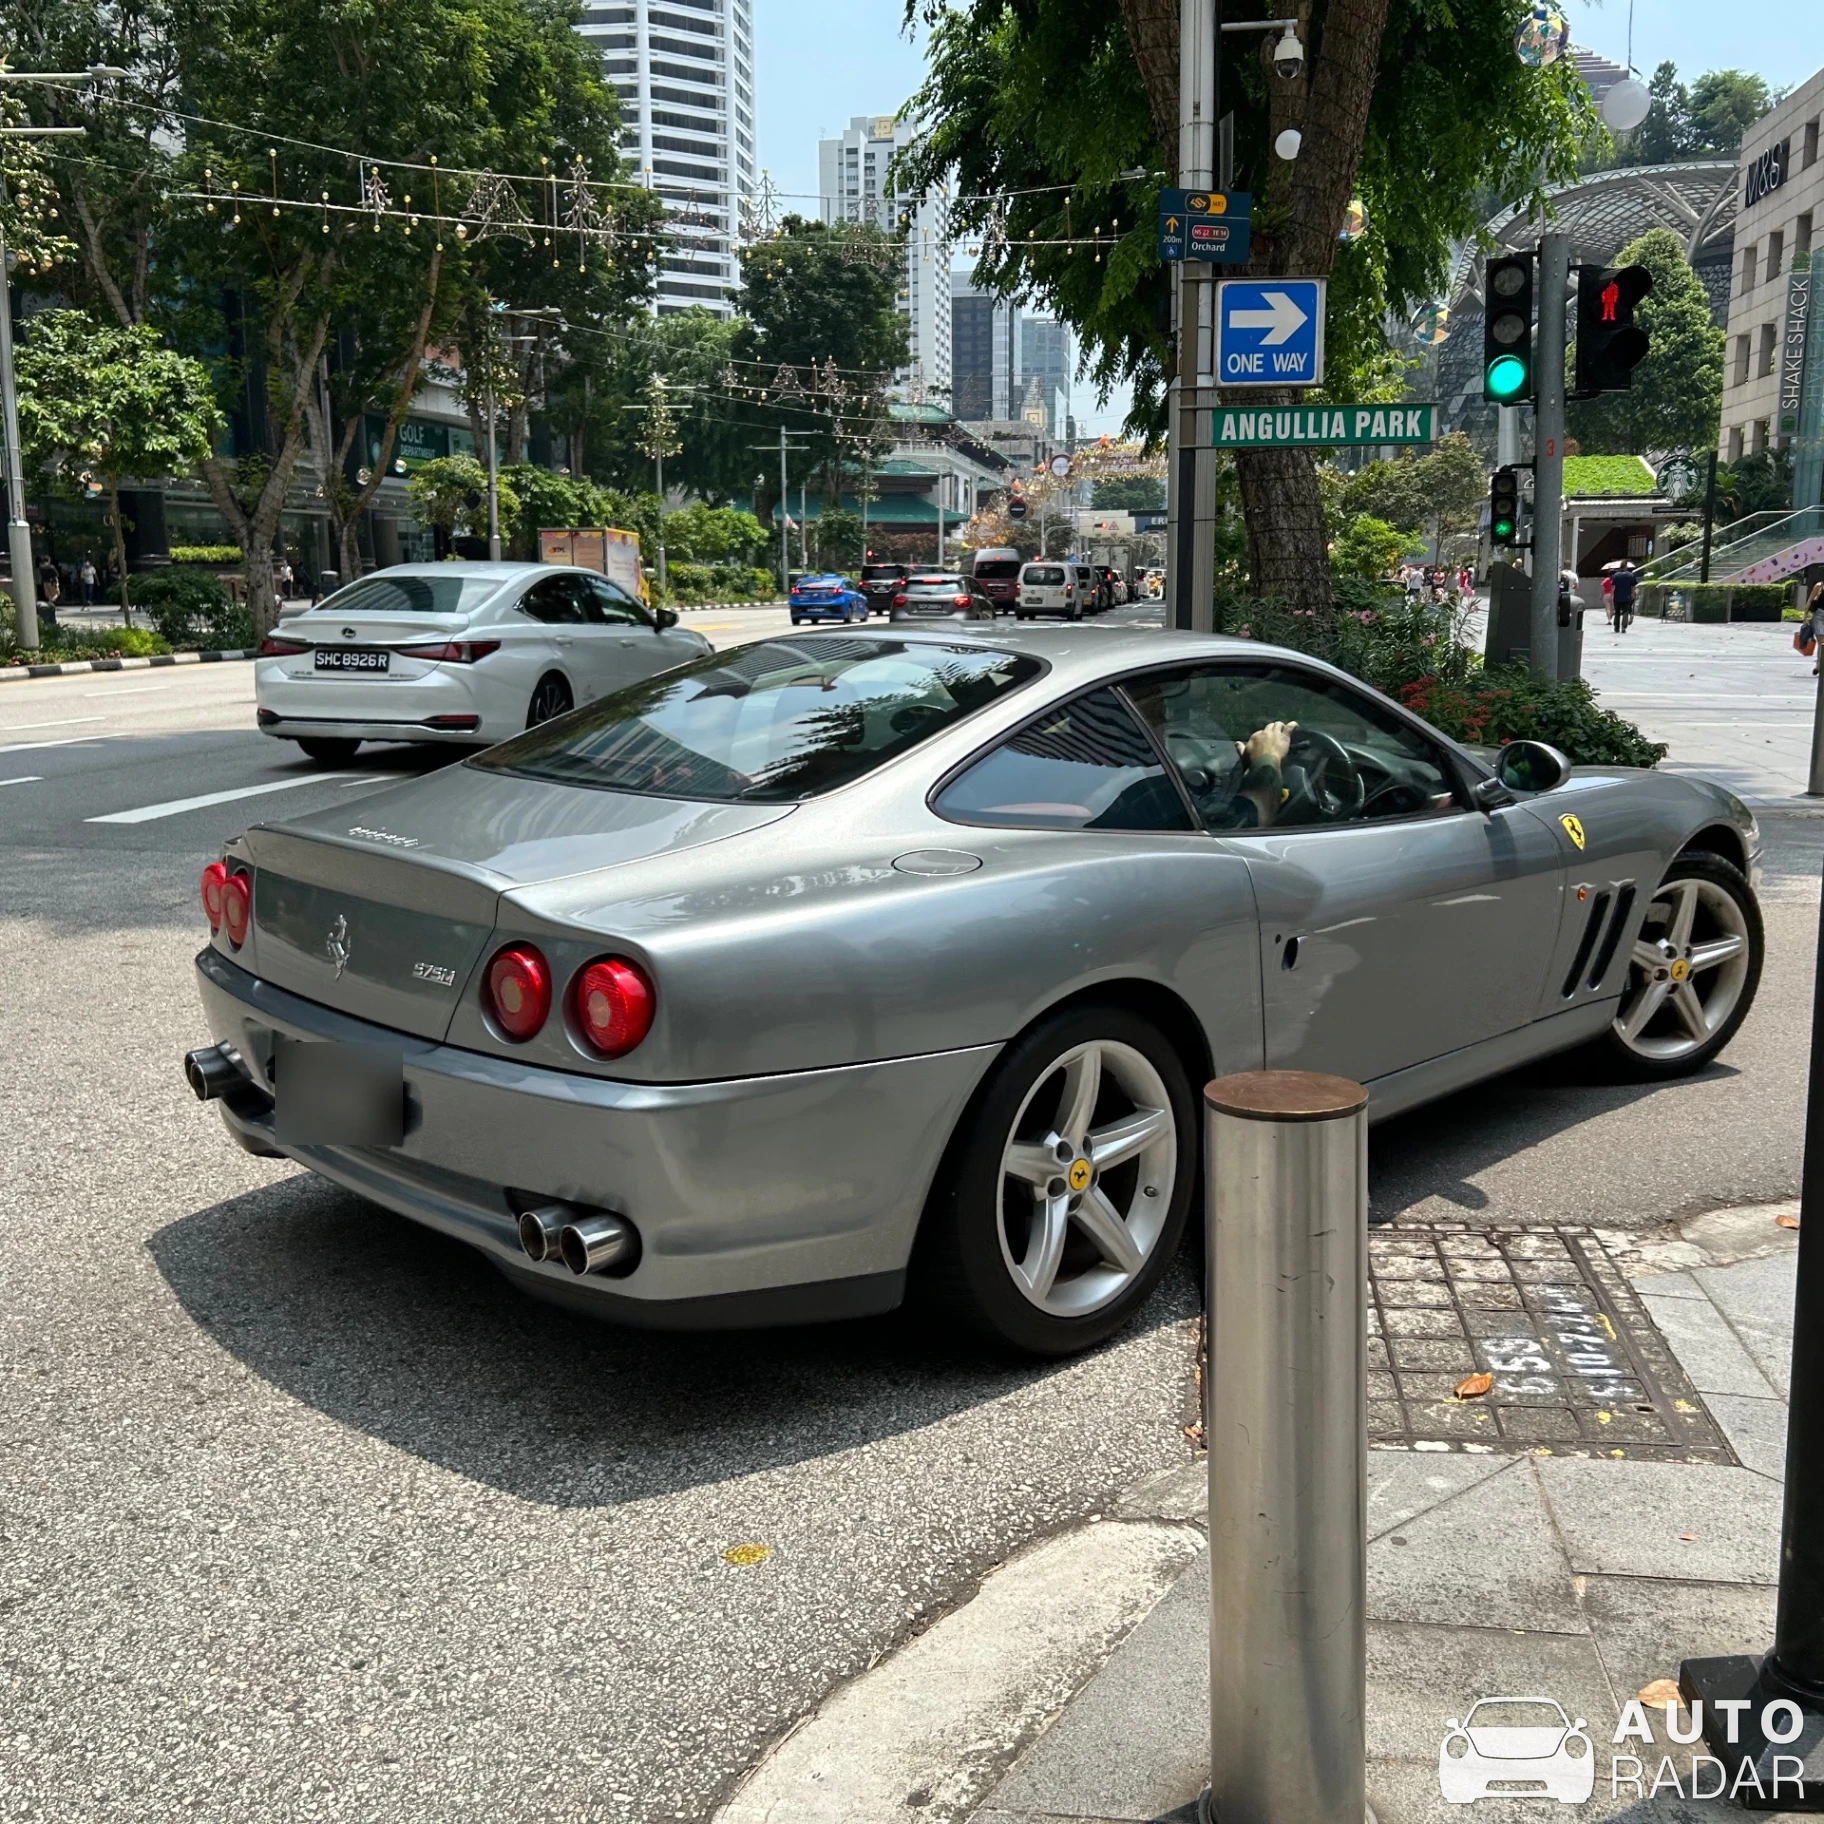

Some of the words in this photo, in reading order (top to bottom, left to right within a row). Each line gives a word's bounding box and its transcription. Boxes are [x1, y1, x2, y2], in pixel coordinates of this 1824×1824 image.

[1745, 140, 1783, 207] M&S
[1211, 200, 1224, 208] MRT
[1162, 235, 1182, 244] 200m
[1191, 241, 1226, 252] Orchard
[1787, 279, 1809, 344] SHACK
[1227, 353, 1264, 373] ONE
[1272, 352, 1308, 372] WAY
[1782, 348, 1802, 410] SHAKE
[399, 424, 425, 444] GOLF
[1220, 411, 1346, 440] ANGULLIA
[1355, 410, 1422, 438] PARK
[400, 444, 436, 459] DEPARTMENT
[1546, 438, 1555, 457] 3
[1151, 517, 1168, 525] ER
[413, 963, 456, 986] 575M
